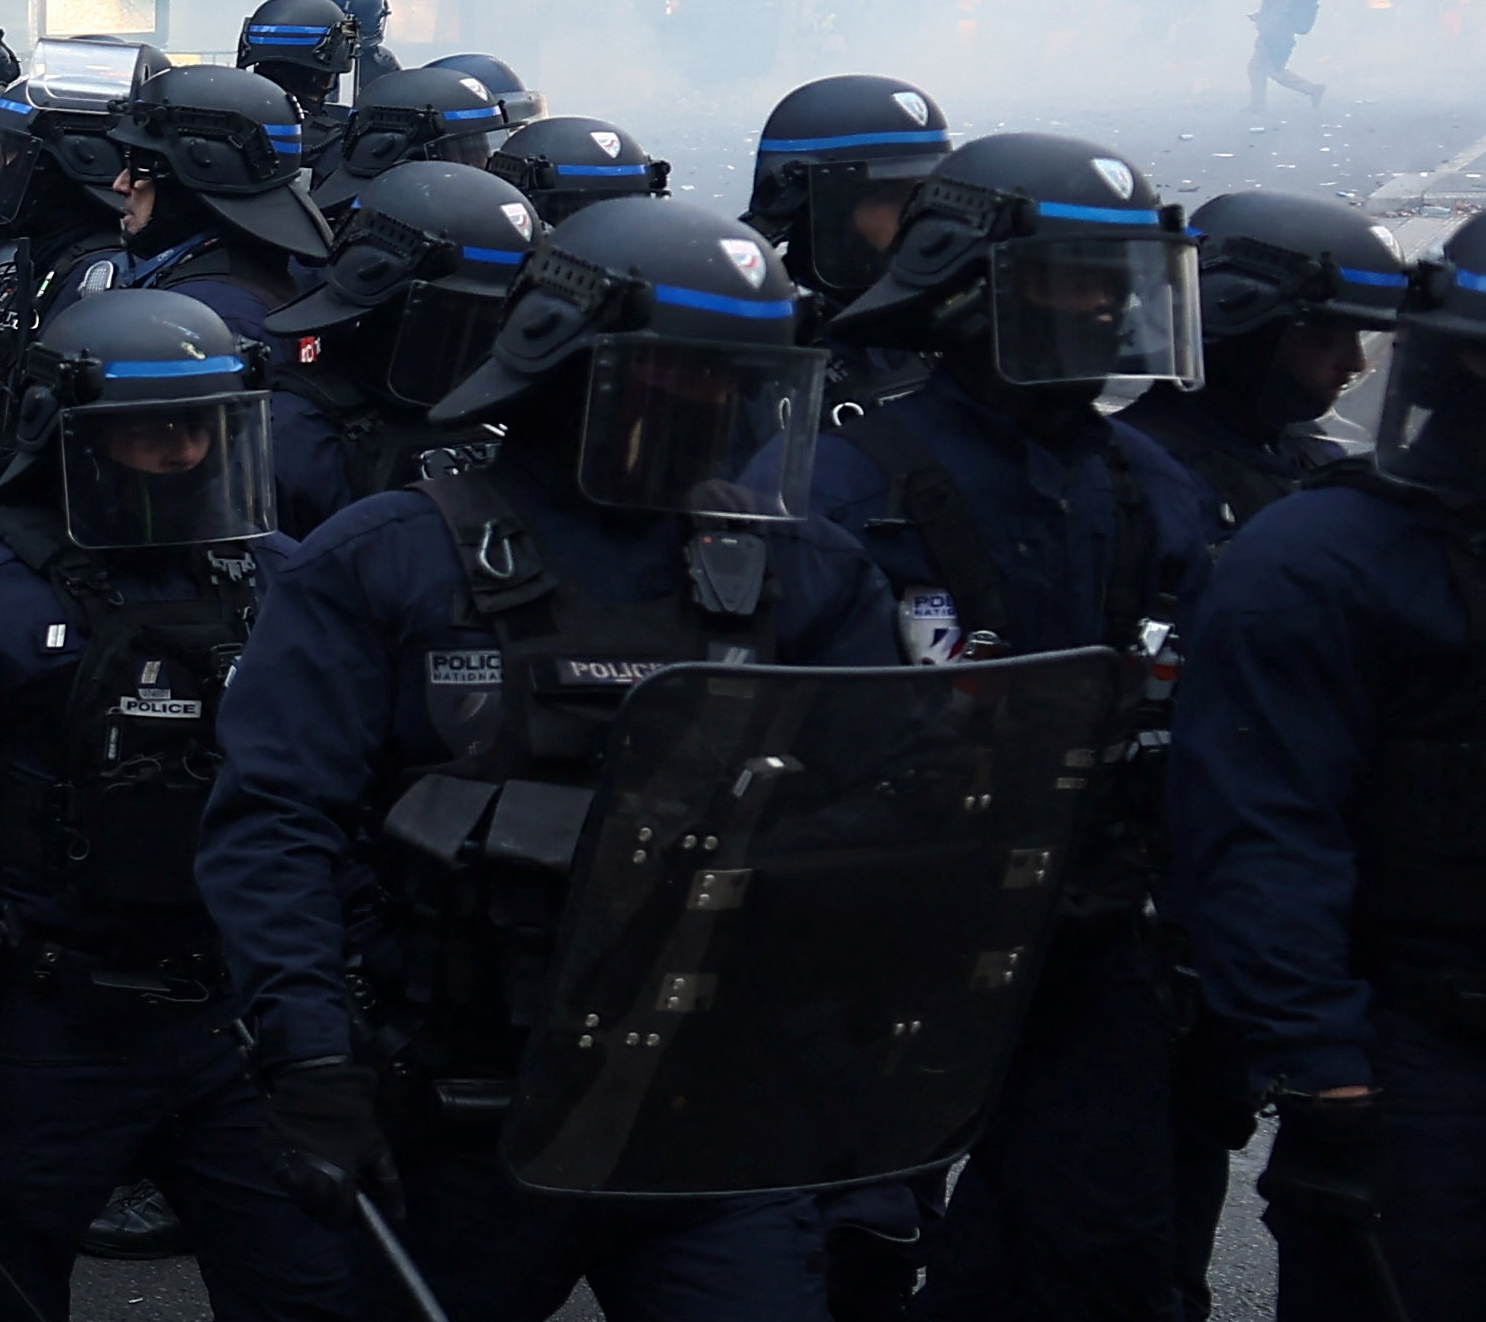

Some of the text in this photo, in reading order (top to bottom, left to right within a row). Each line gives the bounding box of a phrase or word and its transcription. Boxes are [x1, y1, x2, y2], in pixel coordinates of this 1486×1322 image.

[914, 594, 953, 608] POL
[914, 608, 955, 616] NATIO
[433, 654, 501, 671] POLIC
[433, 669, 501, 682] NATIONA
[126, 701, 197, 714] POLICE
